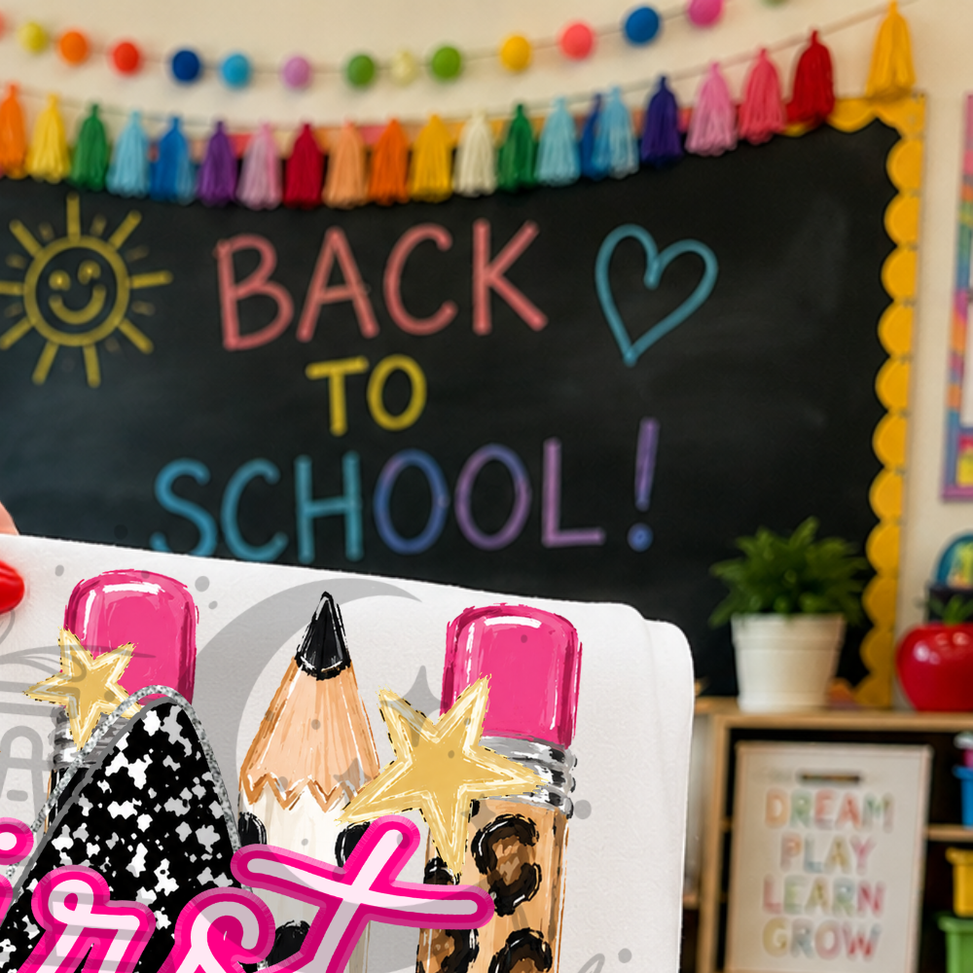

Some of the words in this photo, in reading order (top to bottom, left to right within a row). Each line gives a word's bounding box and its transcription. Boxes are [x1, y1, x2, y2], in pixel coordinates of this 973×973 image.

[214, 218, 547, 350] BACK
[306, 354, 426, 436] TO
[765, 788, 894, 832] DREAM
[780, 833, 875, 874] PLAY
[762, 874, 885, 917] LEARN
[762, 917, 882, 962] GROW
